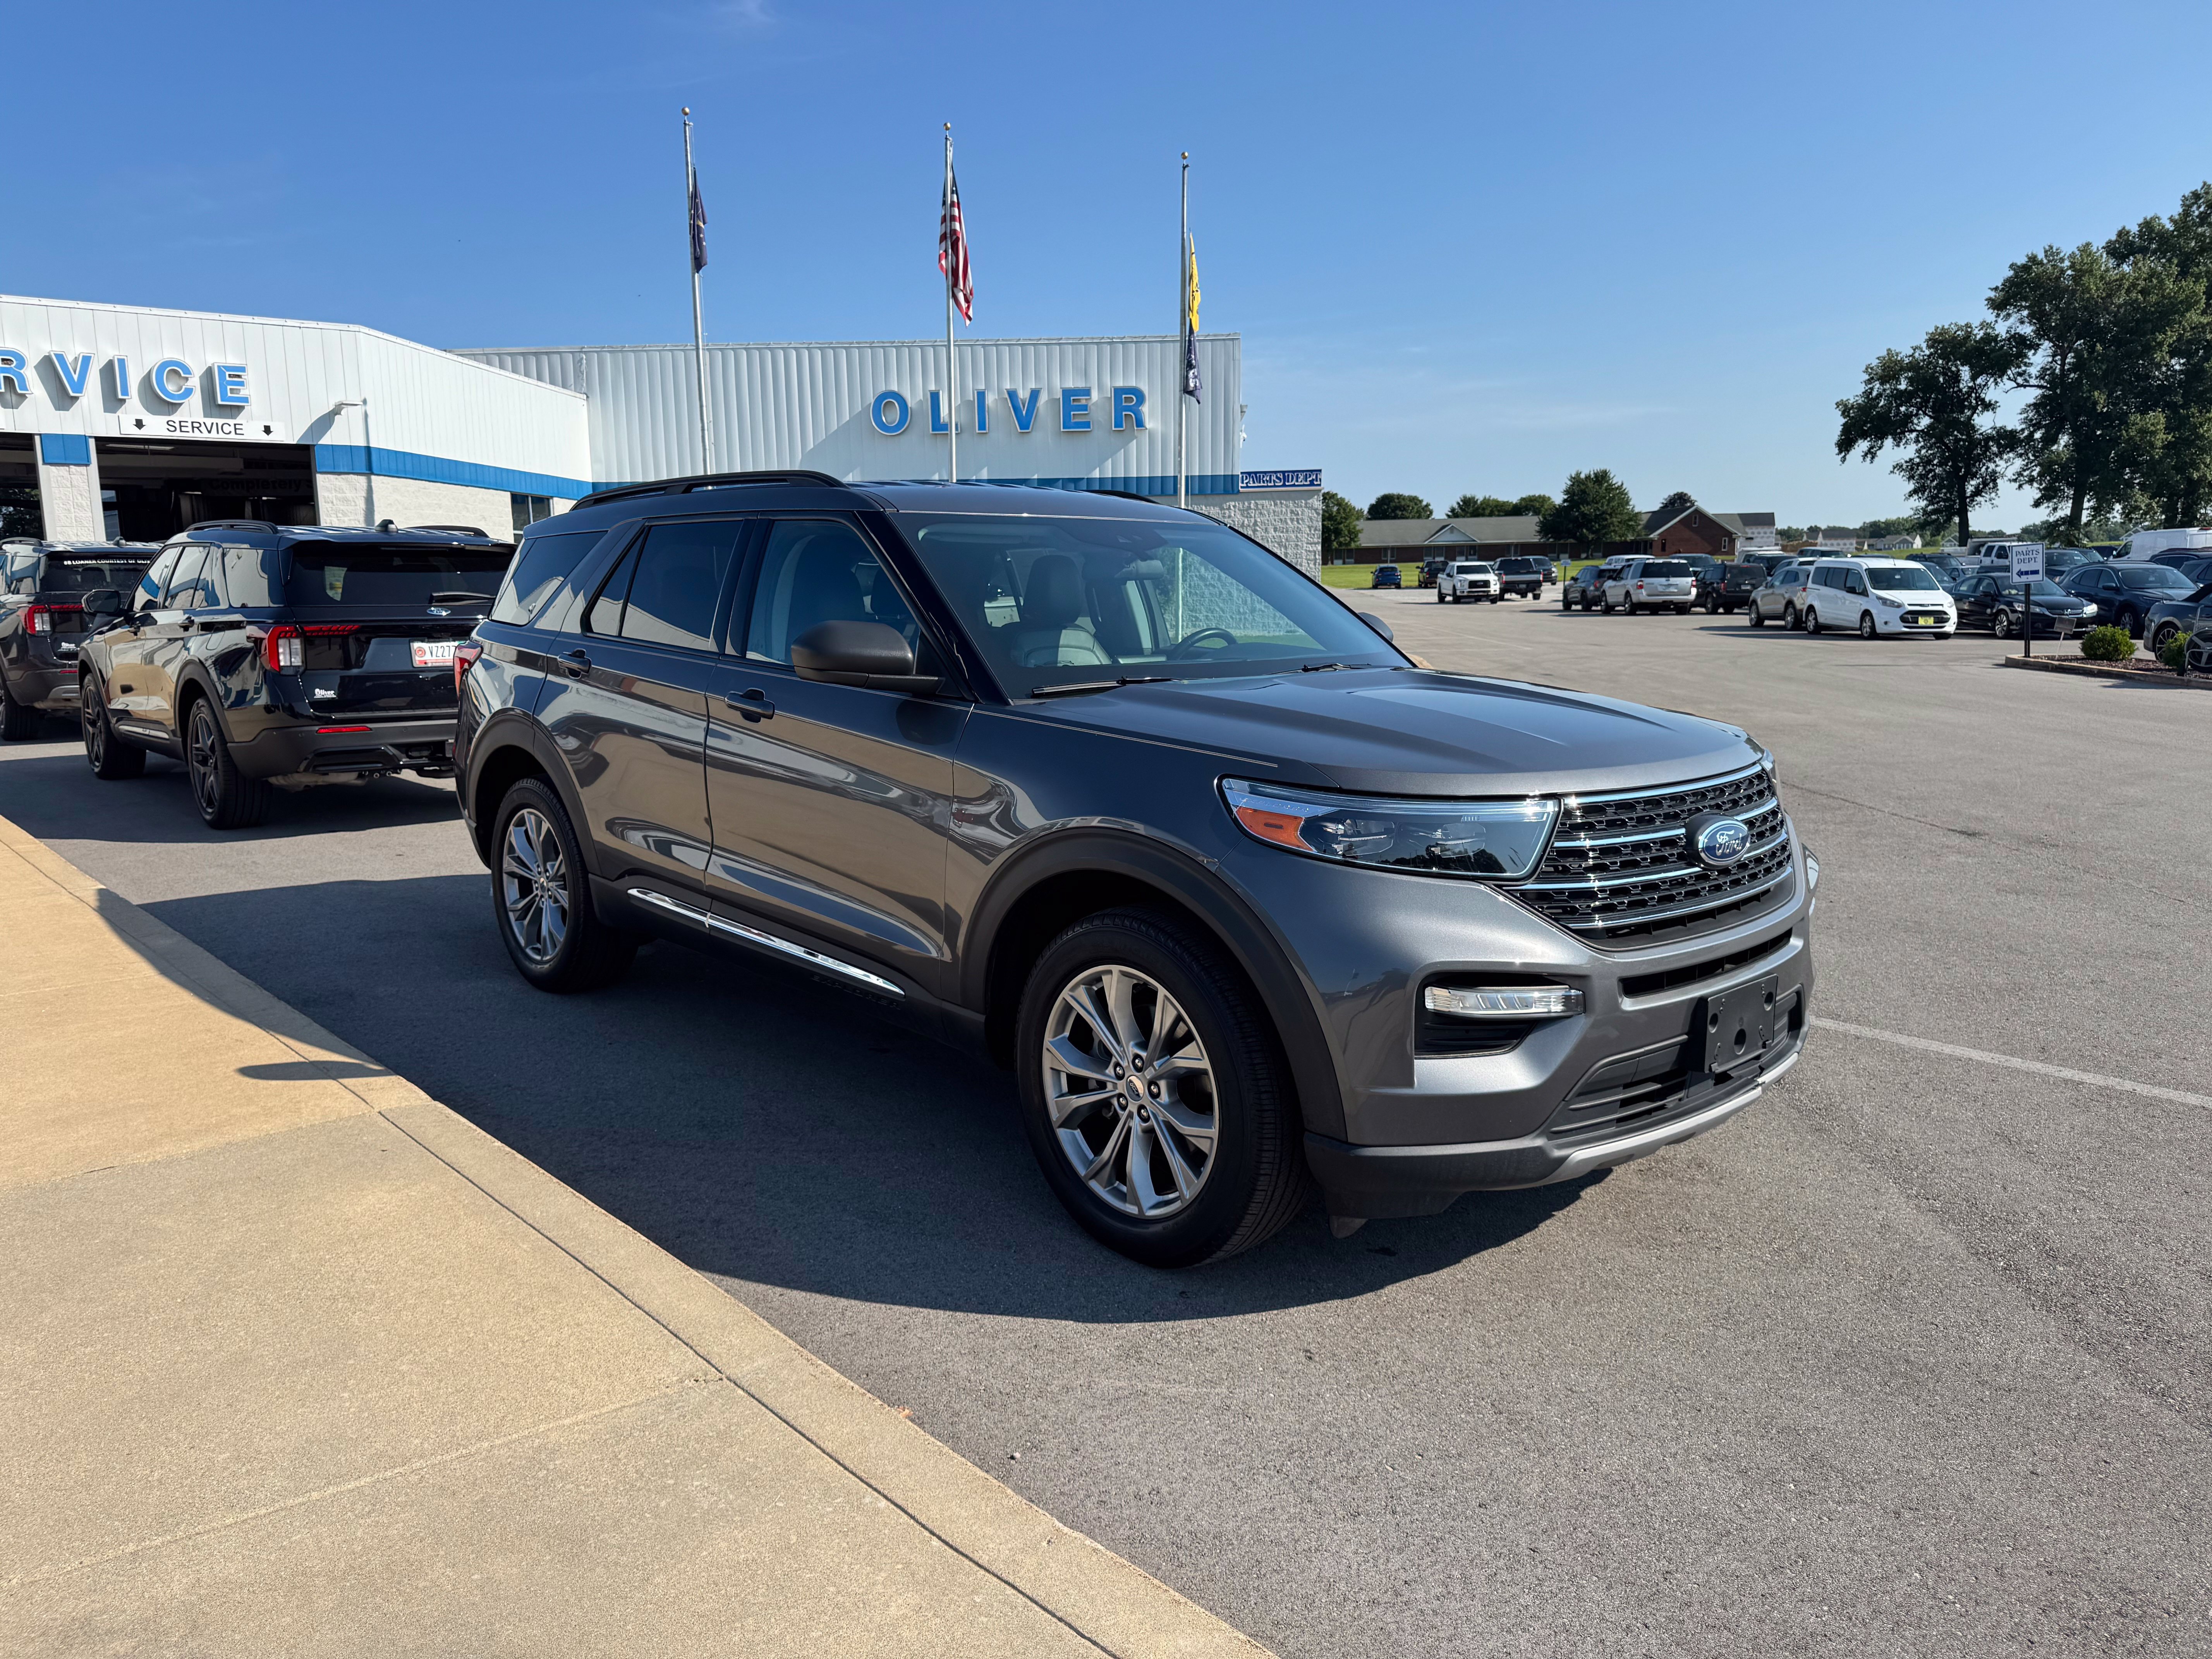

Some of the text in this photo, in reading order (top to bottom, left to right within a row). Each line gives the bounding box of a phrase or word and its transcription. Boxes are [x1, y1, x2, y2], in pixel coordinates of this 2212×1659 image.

[870, 385, 1148, 436] OLIVER
[166, 420, 244, 436] SERVICE
[1240, 472, 1322, 487] PARTS DEPT
[2015, 549, 2040, 557] PARTS
[1716, 830, 1743, 856] Ford
